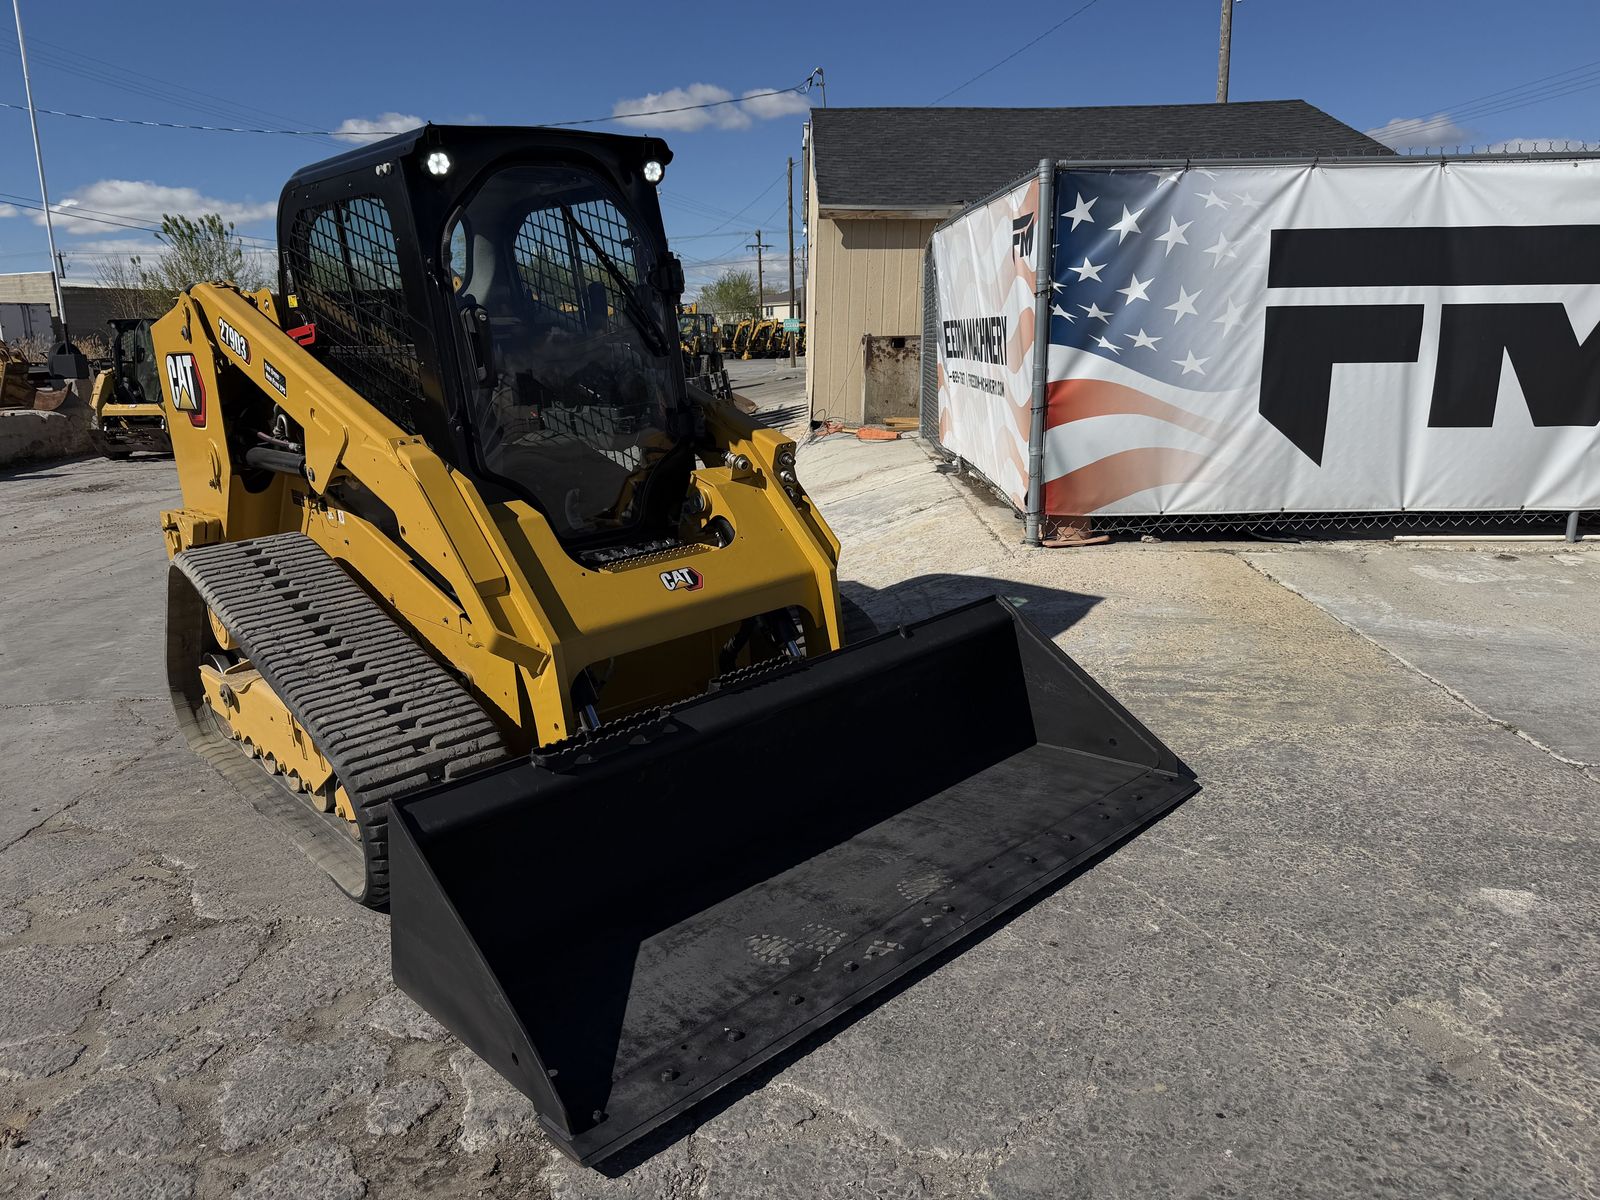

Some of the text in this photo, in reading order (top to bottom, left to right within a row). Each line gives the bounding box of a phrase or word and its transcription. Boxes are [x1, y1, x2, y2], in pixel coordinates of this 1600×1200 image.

[1012, 212, 1035, 266] FM
[218, 316, 247, 361] 279D3
[166, 354, 199, 410] CAT
[660, 568, 694, 591] CAT
